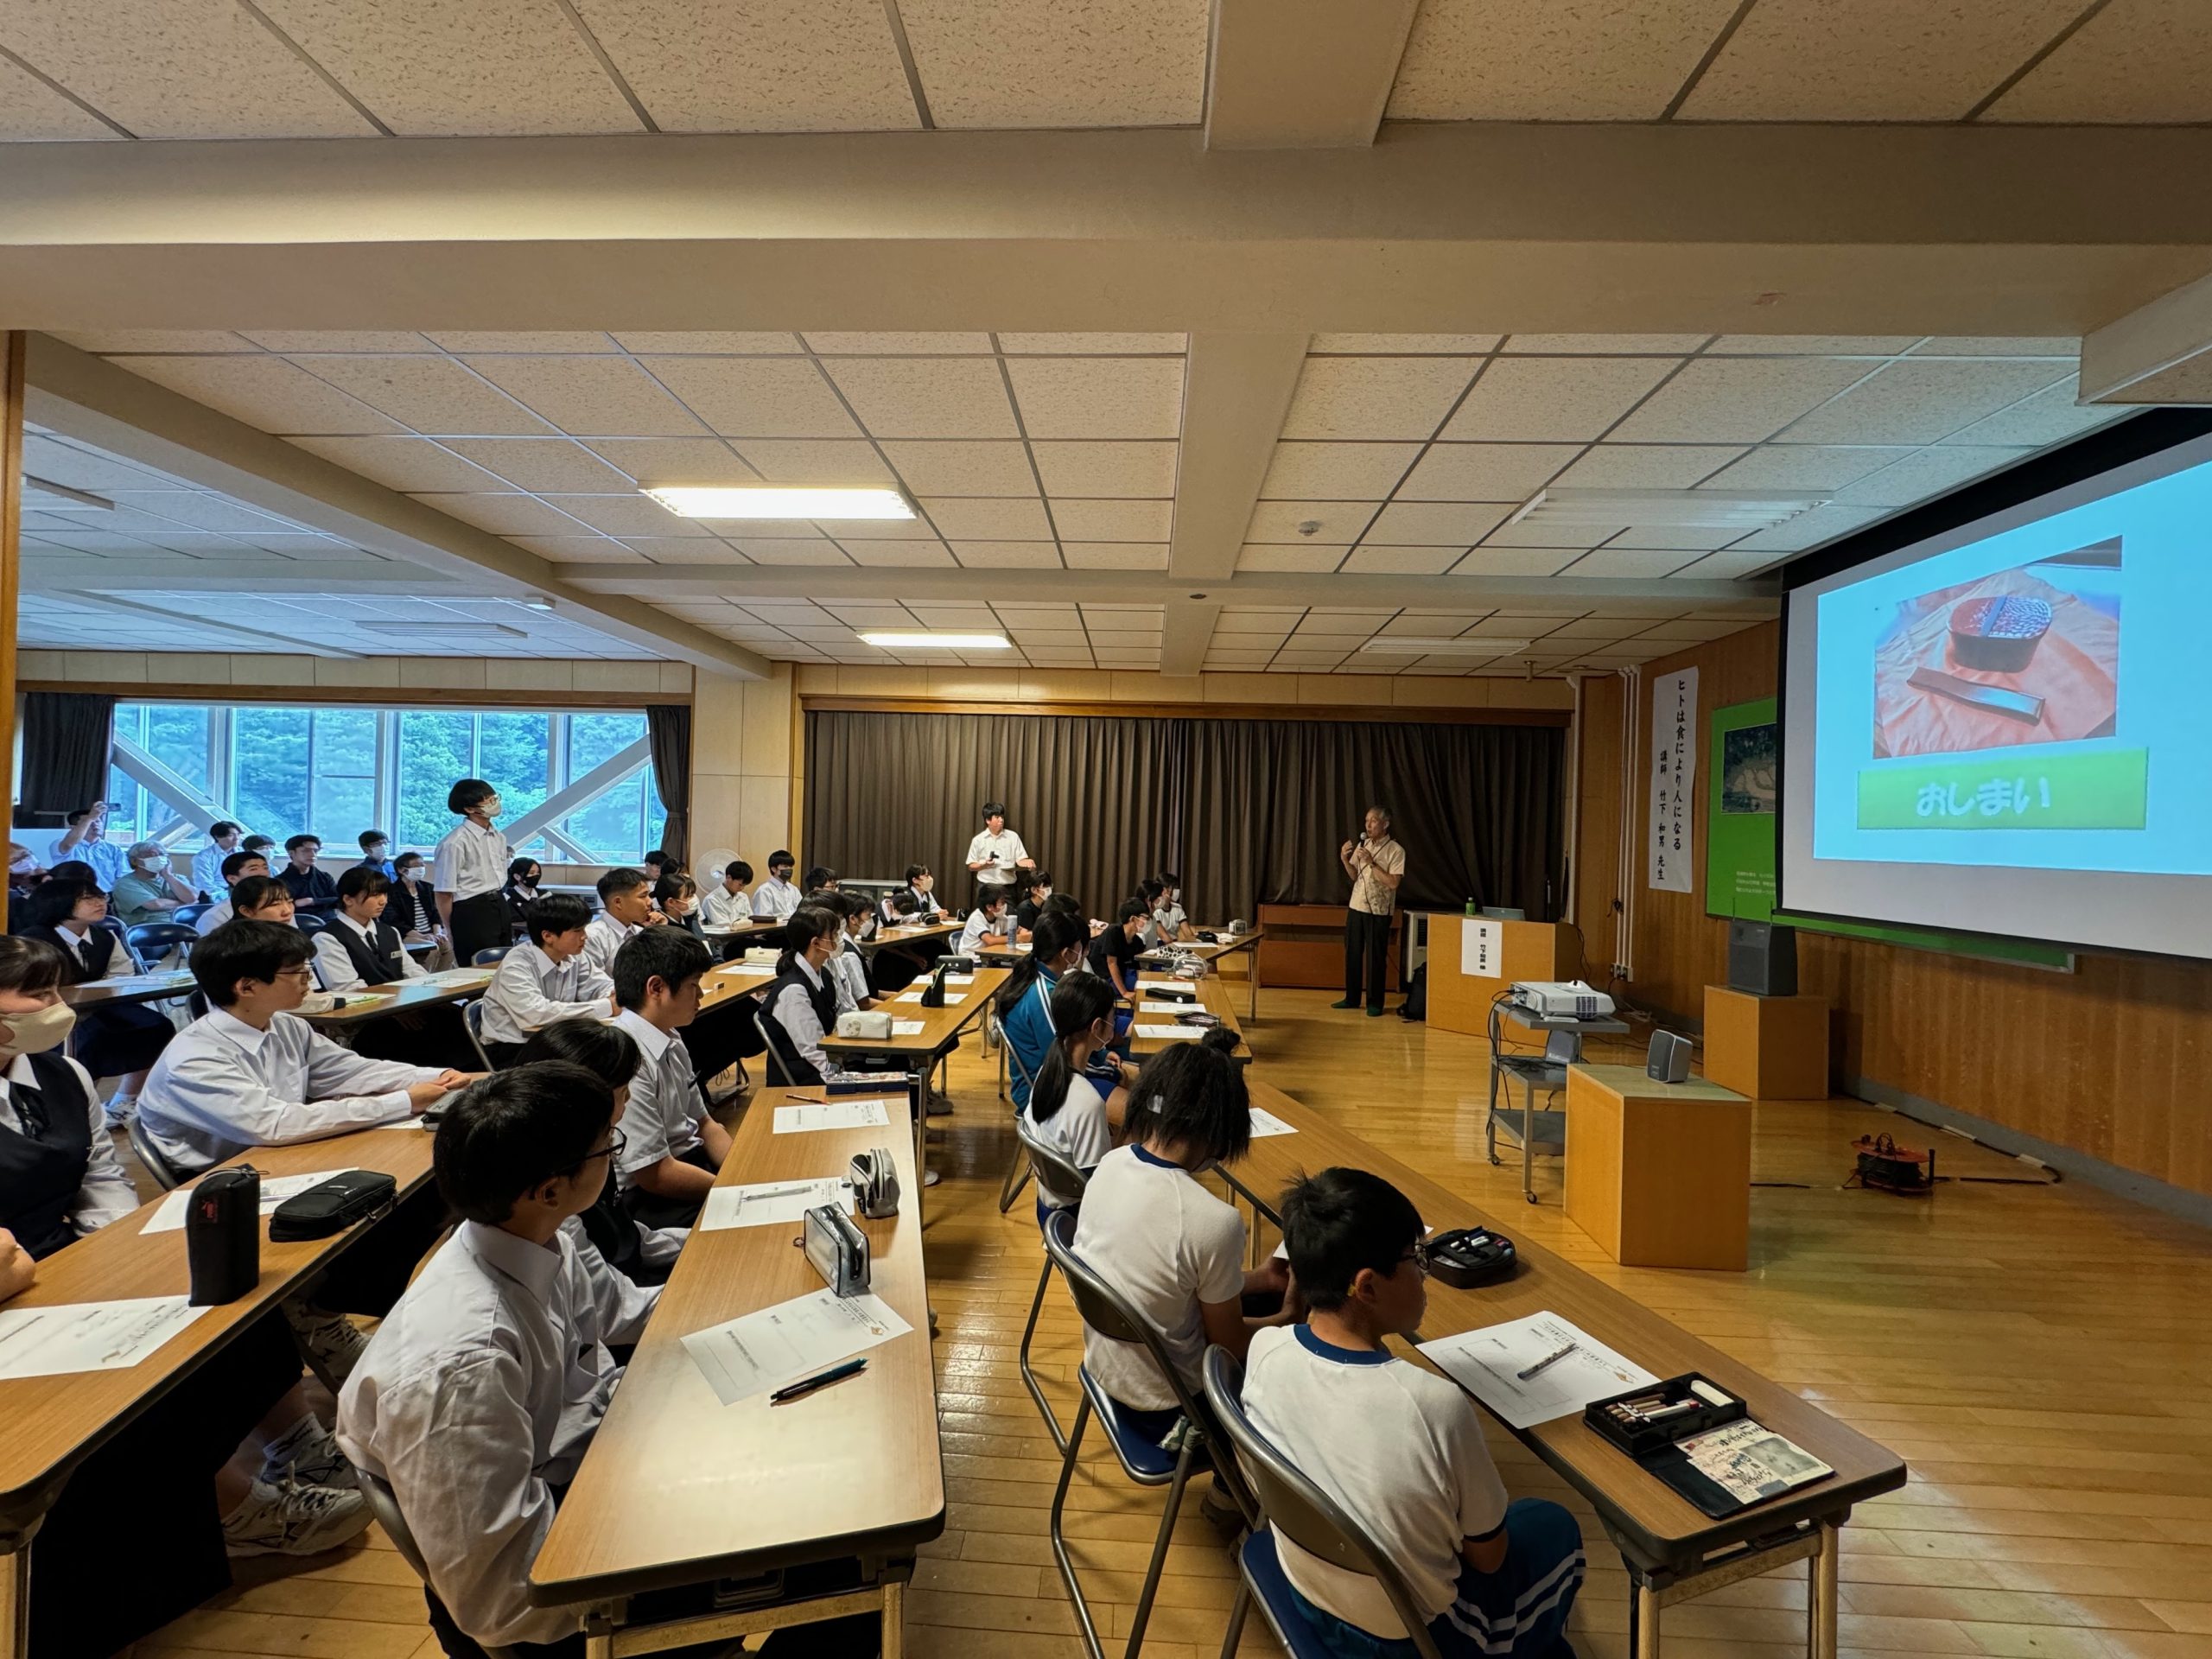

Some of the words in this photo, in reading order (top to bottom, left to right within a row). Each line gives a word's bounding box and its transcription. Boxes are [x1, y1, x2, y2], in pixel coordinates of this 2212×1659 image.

[1660, 749, 1668, 775] 講師
[1673, 679, 1686, 851] ヒトは食により人になる
[1658, 789, 1667, 815] 竹下
[1916, 777, 2051, 817] おしまい
[1656, 854, 1666, 880] 先生
